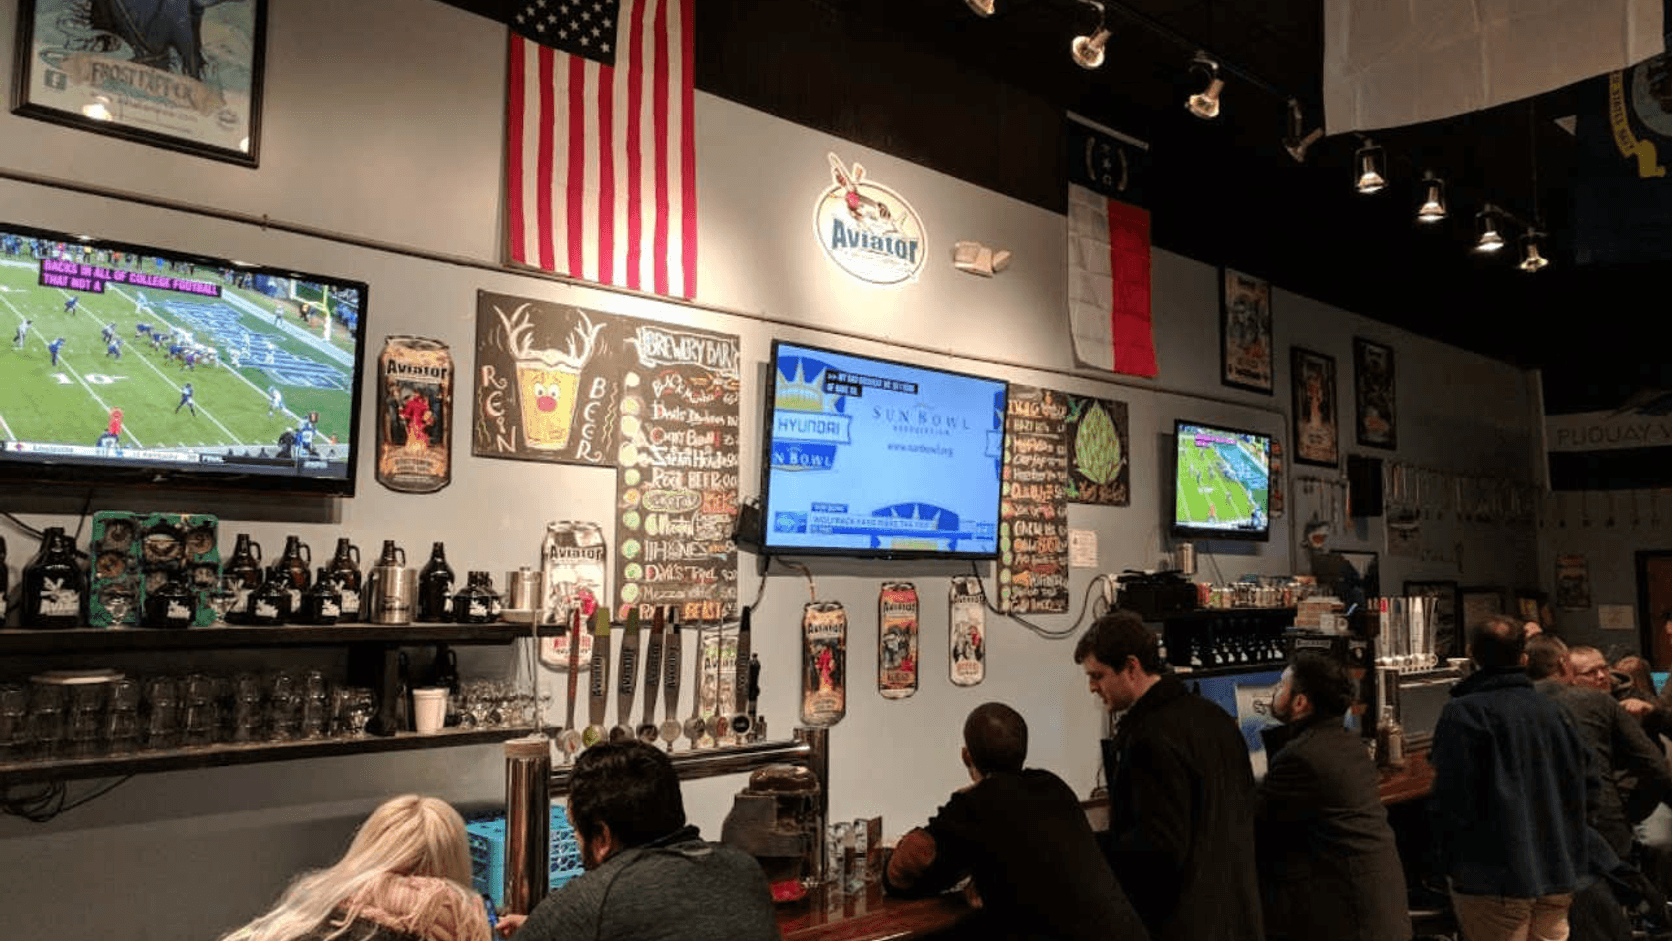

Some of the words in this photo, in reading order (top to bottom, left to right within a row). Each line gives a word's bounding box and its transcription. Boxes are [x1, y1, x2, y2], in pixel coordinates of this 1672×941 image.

[832, 217, 918, 264] Aviator
[387, 359, 448, 379] Aviator
[778, 416, 840, 435] HYUNDAI
[872, 405, 910, 424] SUN
[918, 410, 972, 431] BOWL
[789, 450, 832, 467] BOWL
[550, 545, 602, 560] Aviator
